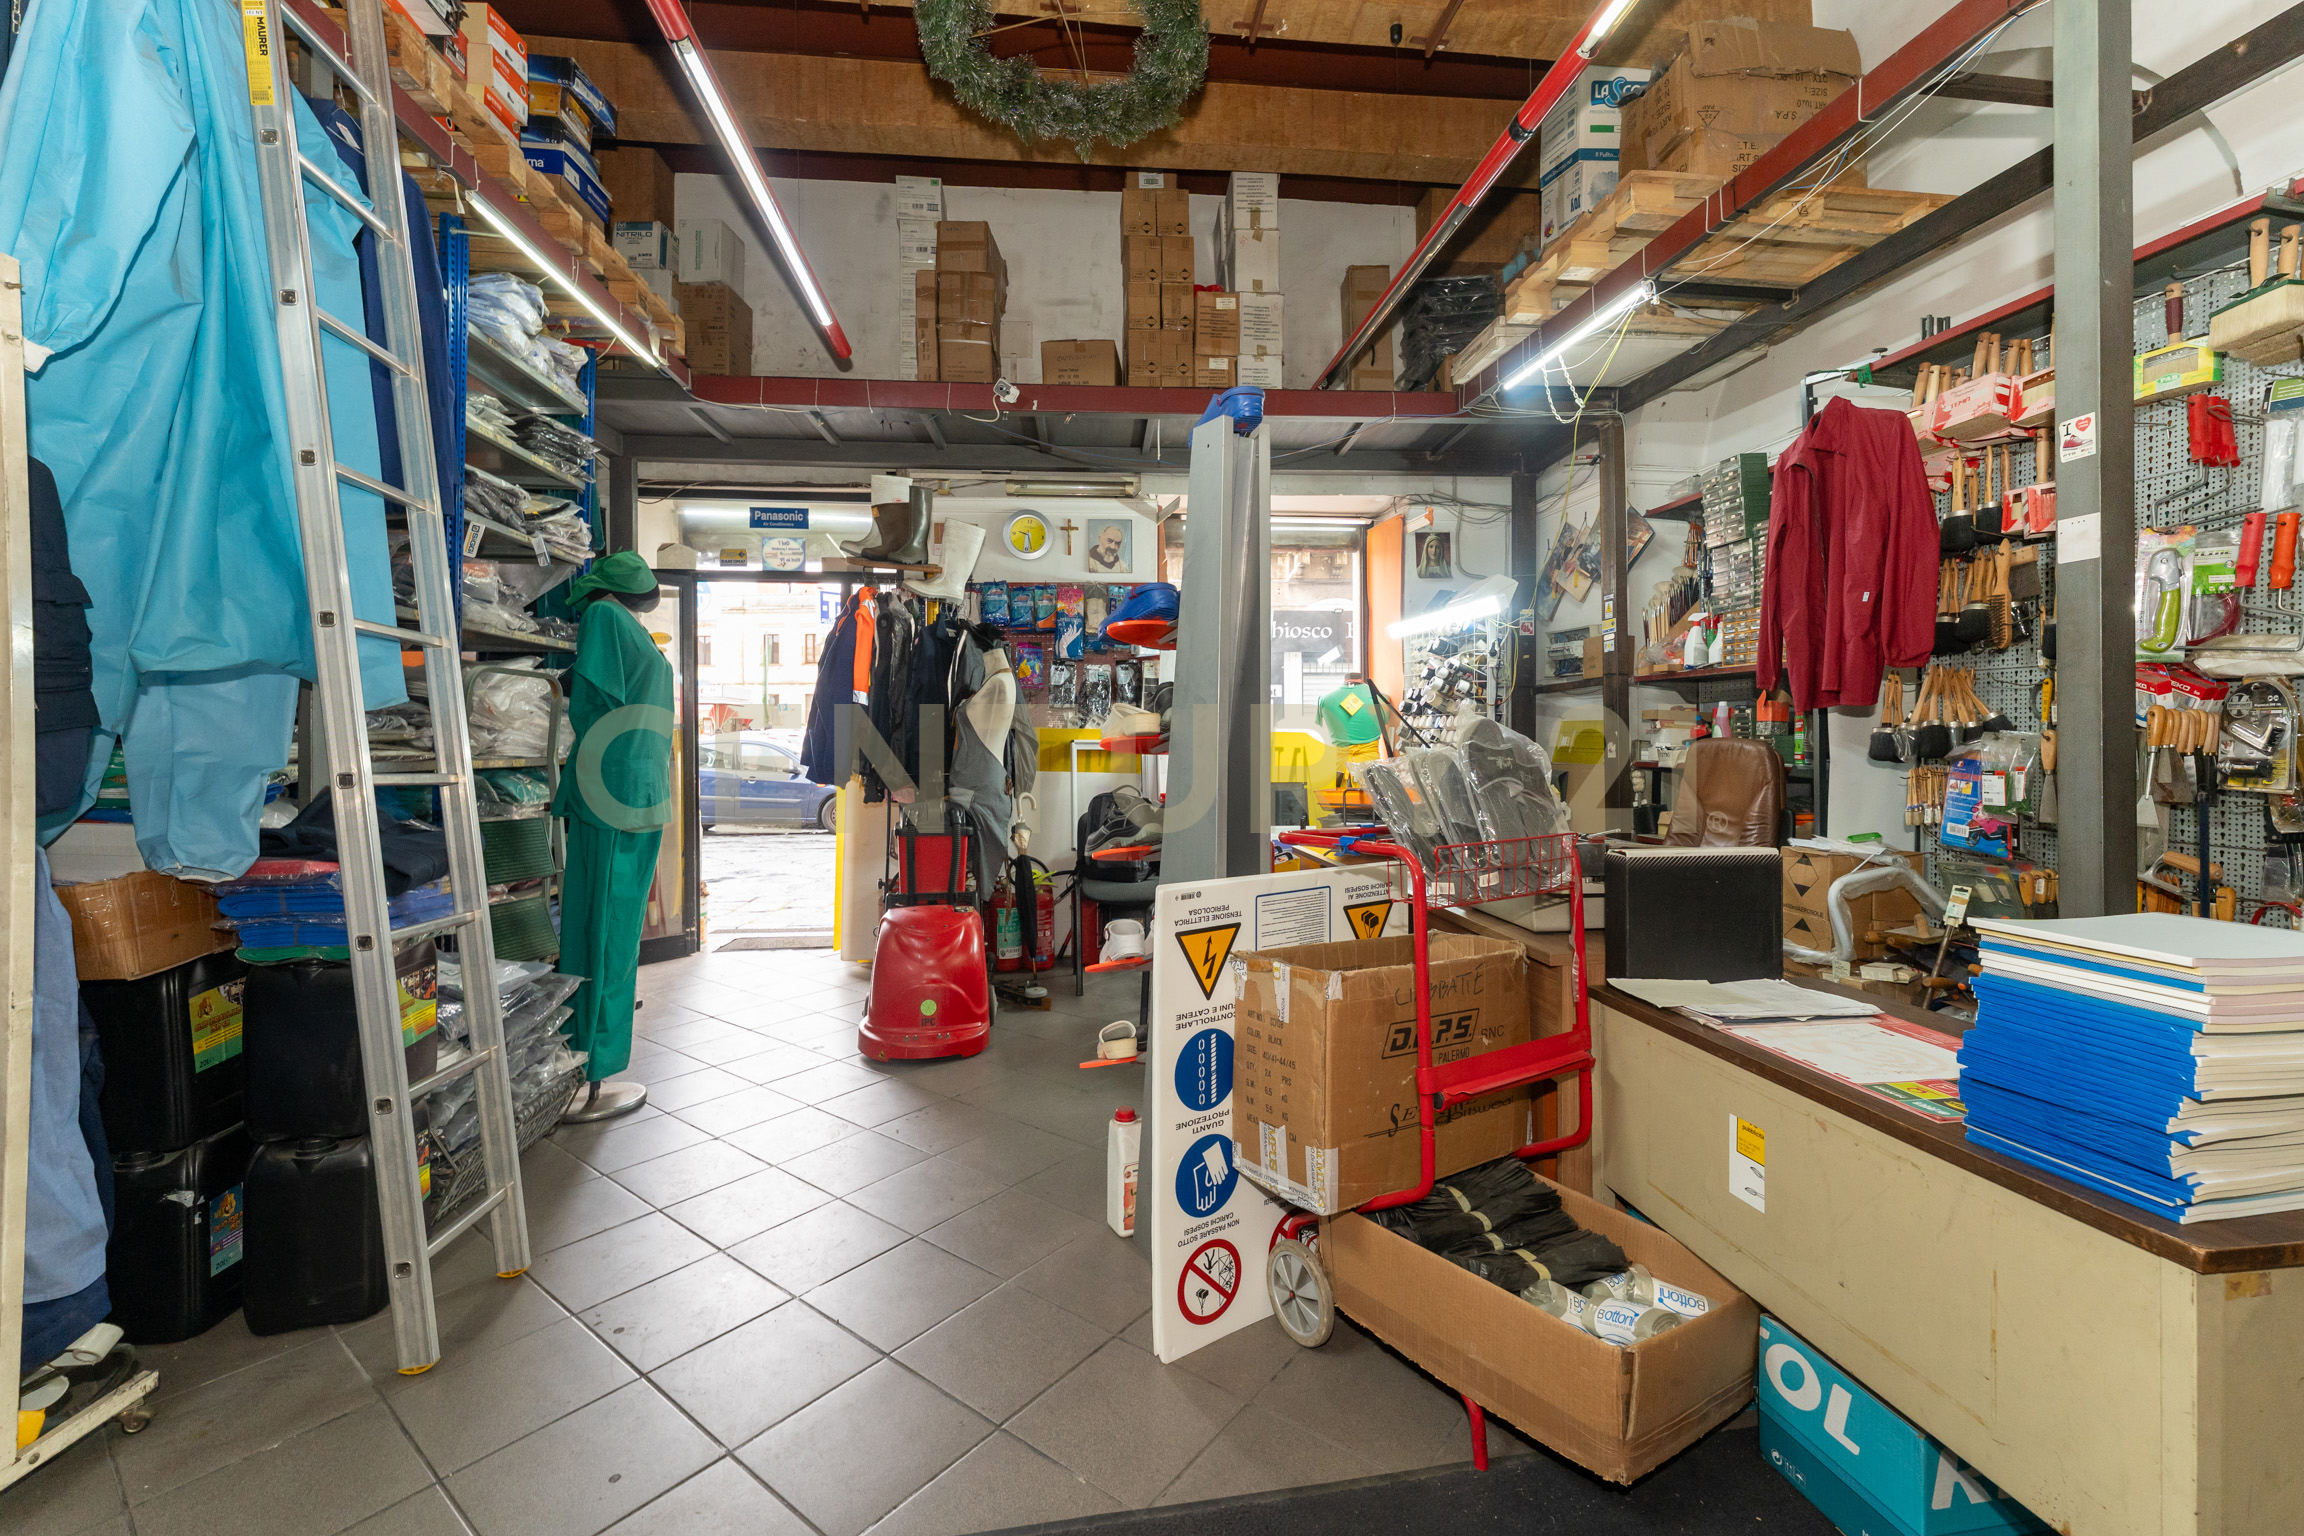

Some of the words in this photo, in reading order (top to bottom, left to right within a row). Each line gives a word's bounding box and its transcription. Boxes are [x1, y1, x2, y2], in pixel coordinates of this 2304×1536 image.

[257, 17, 268, 56] MAURER
[2063, 423, 2071, 437] I
[754, 510, 803, 521] Panasonic
[1272, 621, 1332, 639] hiosco
[1345, 884, 1370, 894] SOSPESI
[1355, 888, 1390, 898] ATTENZIONE
[1188, 904, 1230, 916] PERICOLOSA
[1214, 910, 1242, 922] TENSIONE
[1174, 914, 1213, 926] ELETTRICA
[1175, 1008, 1209, 1021] CATENE
[1268, 1034, 1282, 1047] BLACK
[1389, 1015, 1473, 1053] D..P.S.
[1438, 1047, 1470, 1064] PALERMO
[1264, 1069, 1272, 1078] 24
[1282, 1076, 1292, 1086] PRS
[1264, 1086, 1272, 1096] 6.5
[1175, 1109, 1230, 1131] PROTEZIONE
[1265, 1104, 1273, 1114] 5.5
[1281, 1112, 1288, 1122] KG
[1192, 1120, 1225, 1134] GUANTI
[1211, 1212, 1234, 1227] CARICHI
[1227, 1218, 1240, 1229] NON
[1183, 1220, 1209, 1236] SOSPESI
[1199, 1223, 1227, 1239] PASSARE
[1177, 1234, 1199, 1248] SOTTO
[1659, 1287, 1706, 1311] Bottoni
[1597, 1309, 1636, 1327] Bottoni
